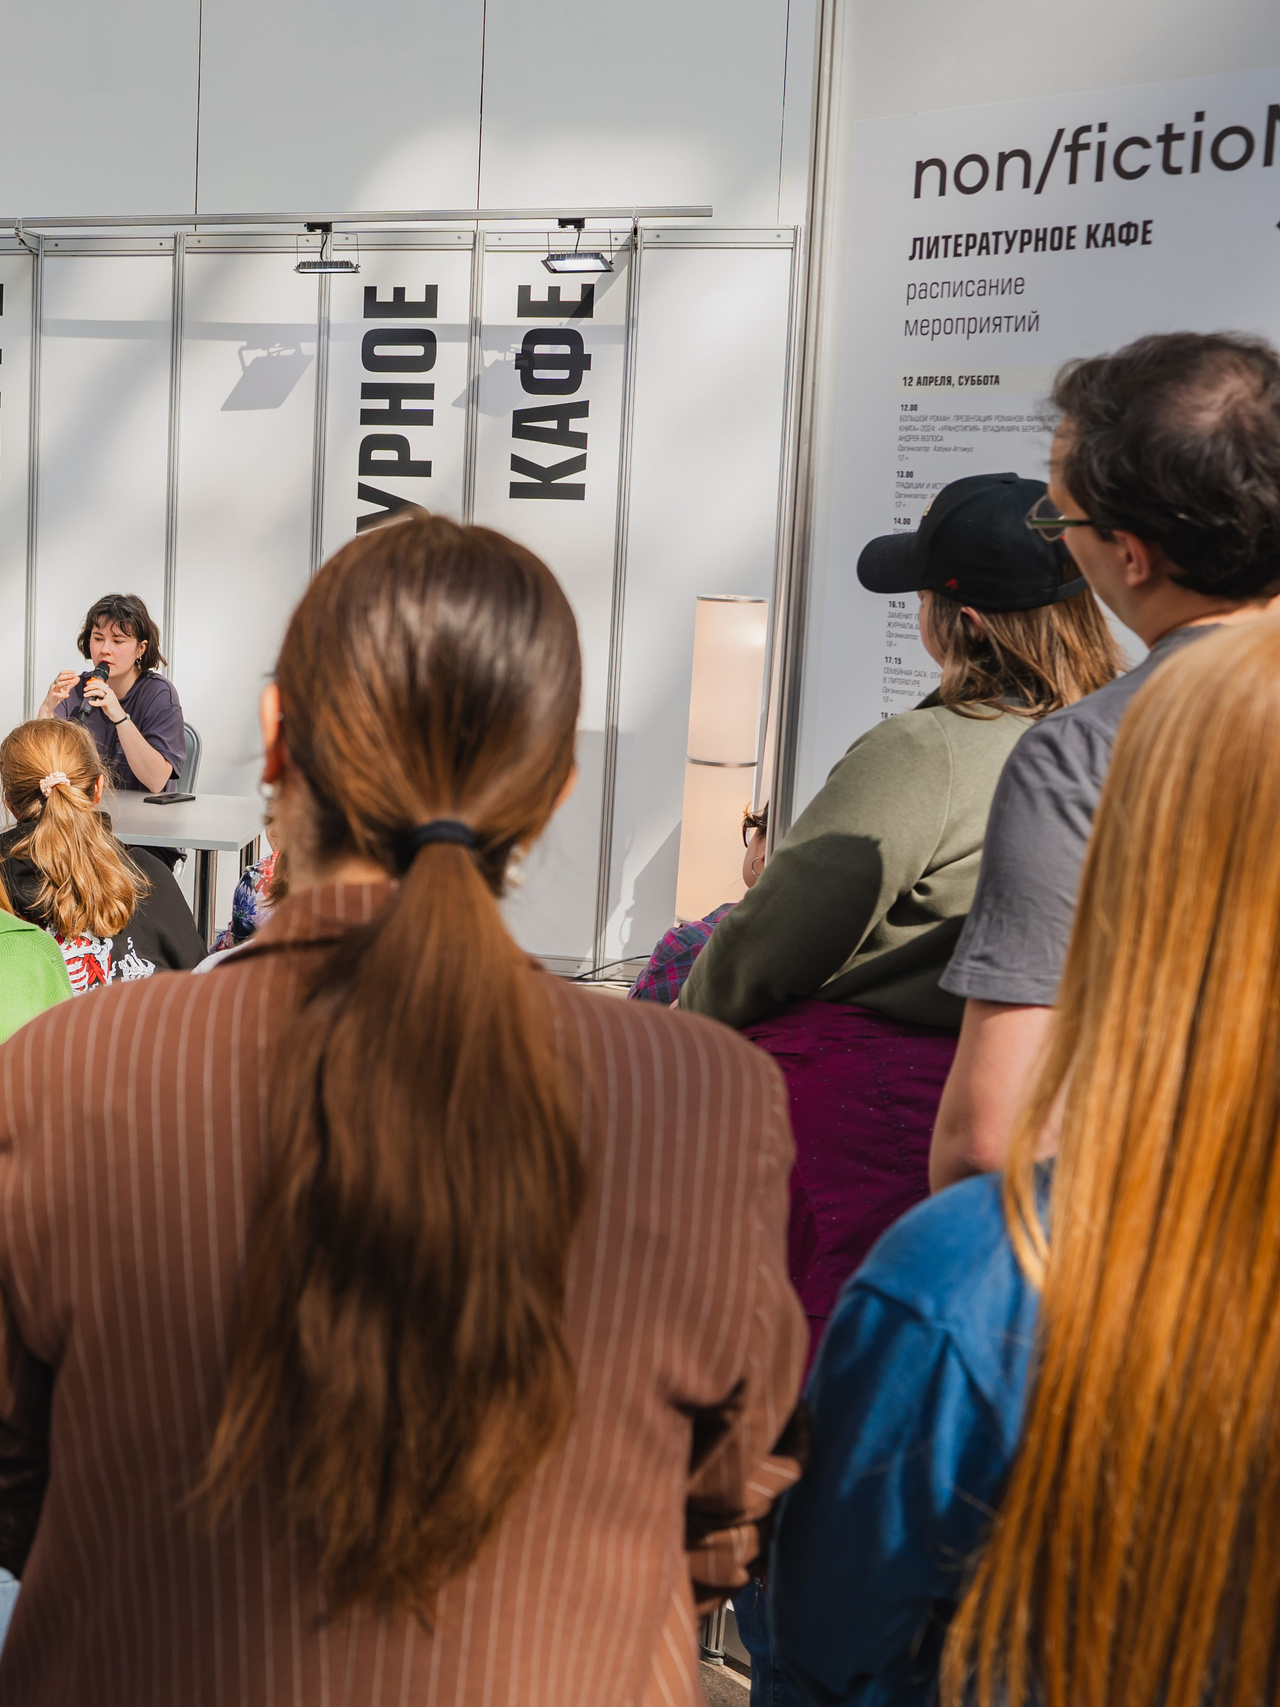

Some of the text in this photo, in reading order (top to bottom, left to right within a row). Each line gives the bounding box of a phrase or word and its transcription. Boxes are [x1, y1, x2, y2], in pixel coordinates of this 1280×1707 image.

[913, 103, 1280, 199] non/fictio
[909, 220, 1153, 261] ЛИТЕРАТУРНОЕ КАФЕ
[906, 275, 1025, 306] расписание
[904, 310, 1039, 341] мероприятий
[509, 284, 594, 500] КАФЕ
[903, 375, 999, 387] 12 АПРЕЛЯ, СУББОТА
[899, 414, 928, 422] БОЛЬШОЙ
[885, 656, 902, 665] 17.15
